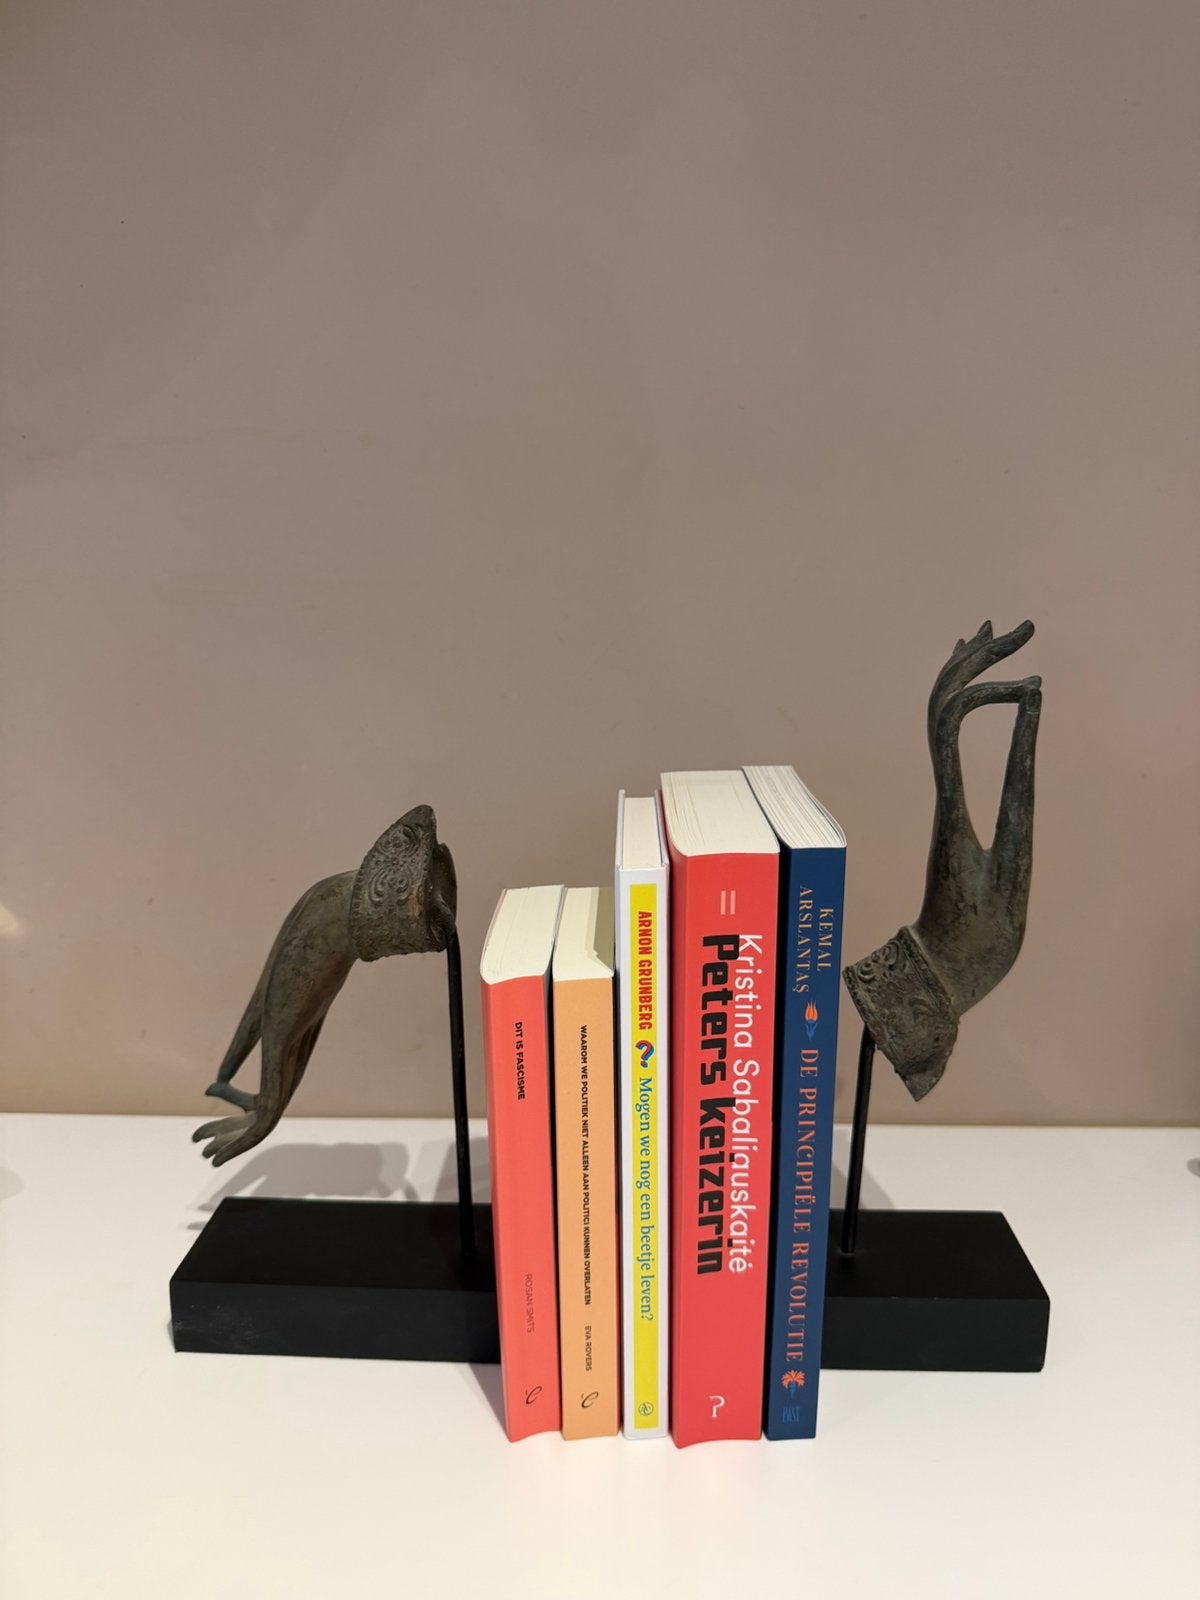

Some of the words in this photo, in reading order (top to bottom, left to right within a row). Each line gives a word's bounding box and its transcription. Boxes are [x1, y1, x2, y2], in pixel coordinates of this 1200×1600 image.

[638, 911, 652, 955] ARNON
[817, 908, 834, 971] KEMAL
[638, 959, 652, 1031] GRUNBERG
[700, 934, 739, 1085] Peters
[733, 934, 763, 1048] Kristina
[515, 1022, 523, 1038] DIT
[515, 1041, 524, 1050] IS
[580, 1025, 588, 1064] WAAROM
[516, 1052, 525, 1100] FASCISME
[580, 1066, 588, 1079] WE
[800, 1049, 819, 1078] DE
[635, 1077, 652, 1132] Mogen
[582, 1140, 590, 1171] ALLEEN
[639, 1135, 650, 1156] we
[793, 1088, 817, 1232] PRINCIPIËLE
[582, 1172, 590, 1190] AAN
[635, 1160, 651, 1190] nog
[729, 1059, 760, 1272] Sabaliauskaitė
[697, 1097, 736, 1275] keizerin
[640, 1194, 650, 1221] een
[583, 1226, 591, 1259] KUNNEN
[636, 1226, 655, 1271] beetje
[525, 1274, 534, 1306] ROSAN
[584, 1260, 592, 1305] OVERLATEN
[640, 1274, 655, 1321] leven?
[786, 1242, 810, 1362] REVOLUTIE
[526, 1307, 535, 1334] SMITS
[584, 1325, 592, 1340] EVA
[585, 1342, 593, 1371] ROVERS
